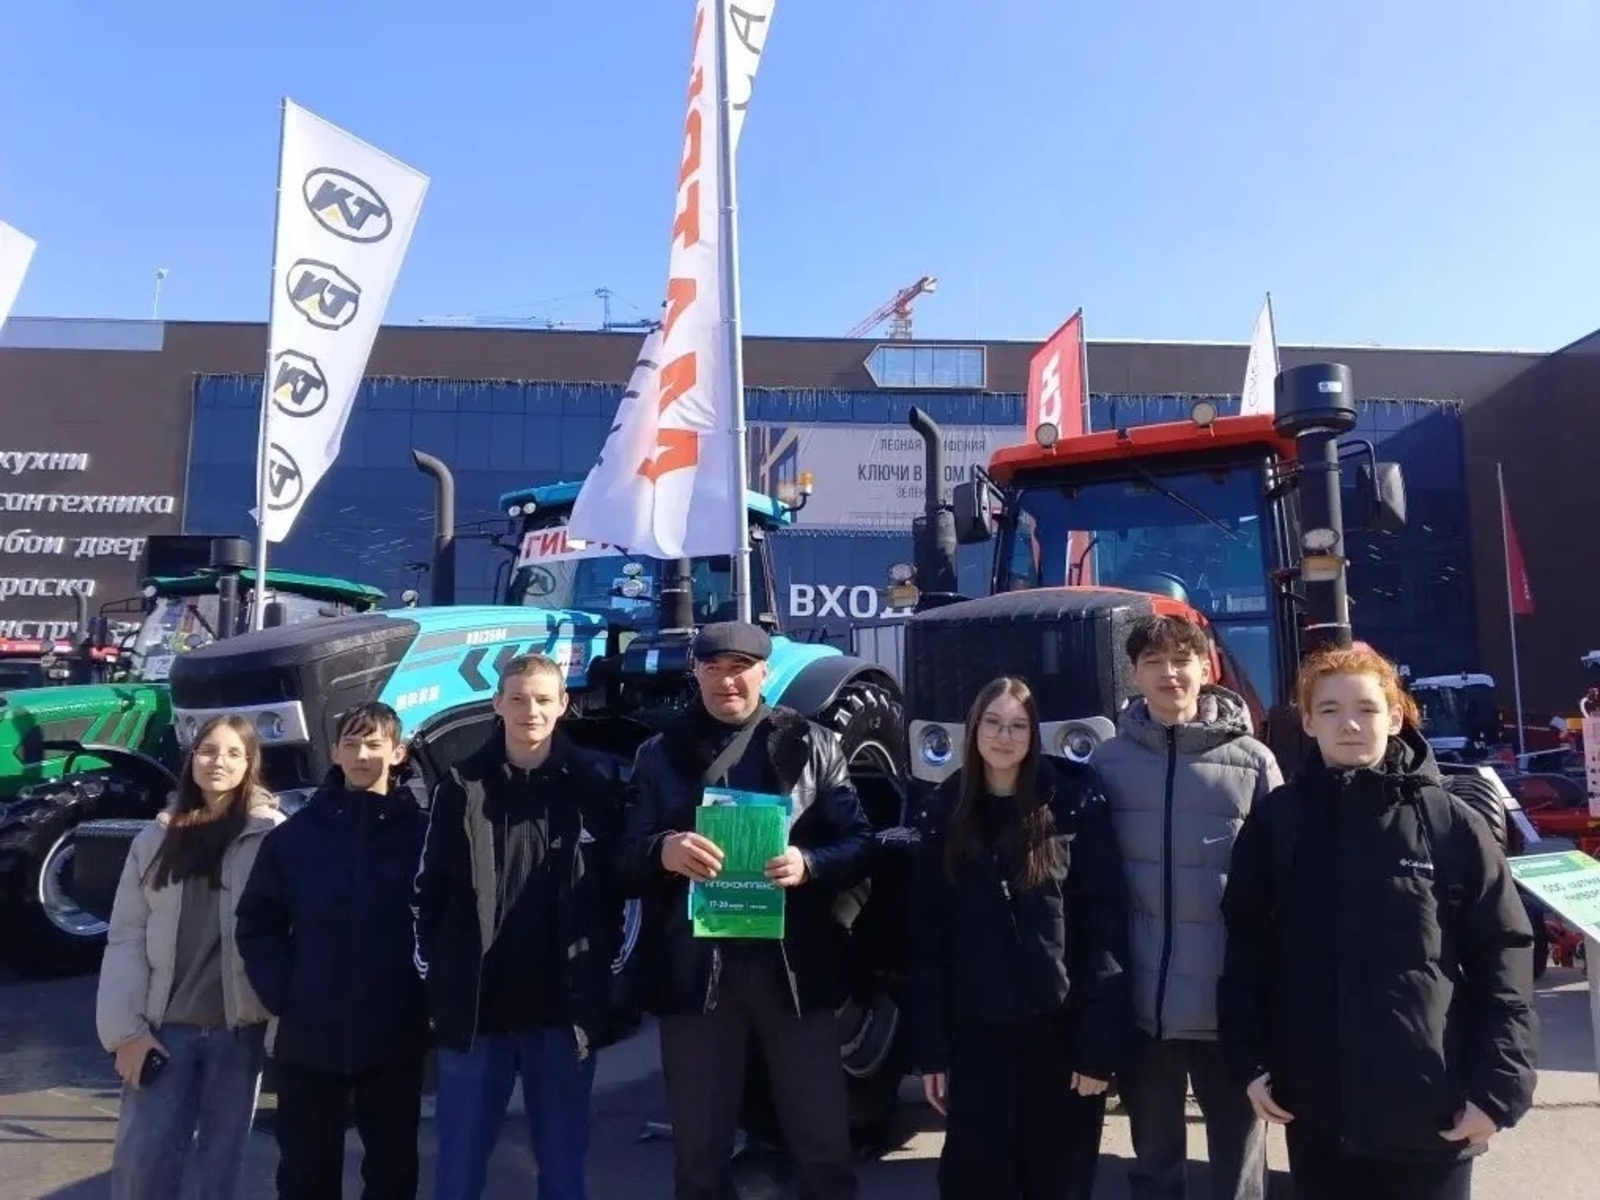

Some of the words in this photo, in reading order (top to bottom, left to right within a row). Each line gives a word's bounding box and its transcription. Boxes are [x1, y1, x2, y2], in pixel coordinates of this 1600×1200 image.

[858, 464, 909, 481] КЛЮЧИ
[913, 466, 922, 481] В
[944, 466, 965, 482] ОМ
[0, 529, 64, 554] бои
[74, 536, 146, 561] двер
